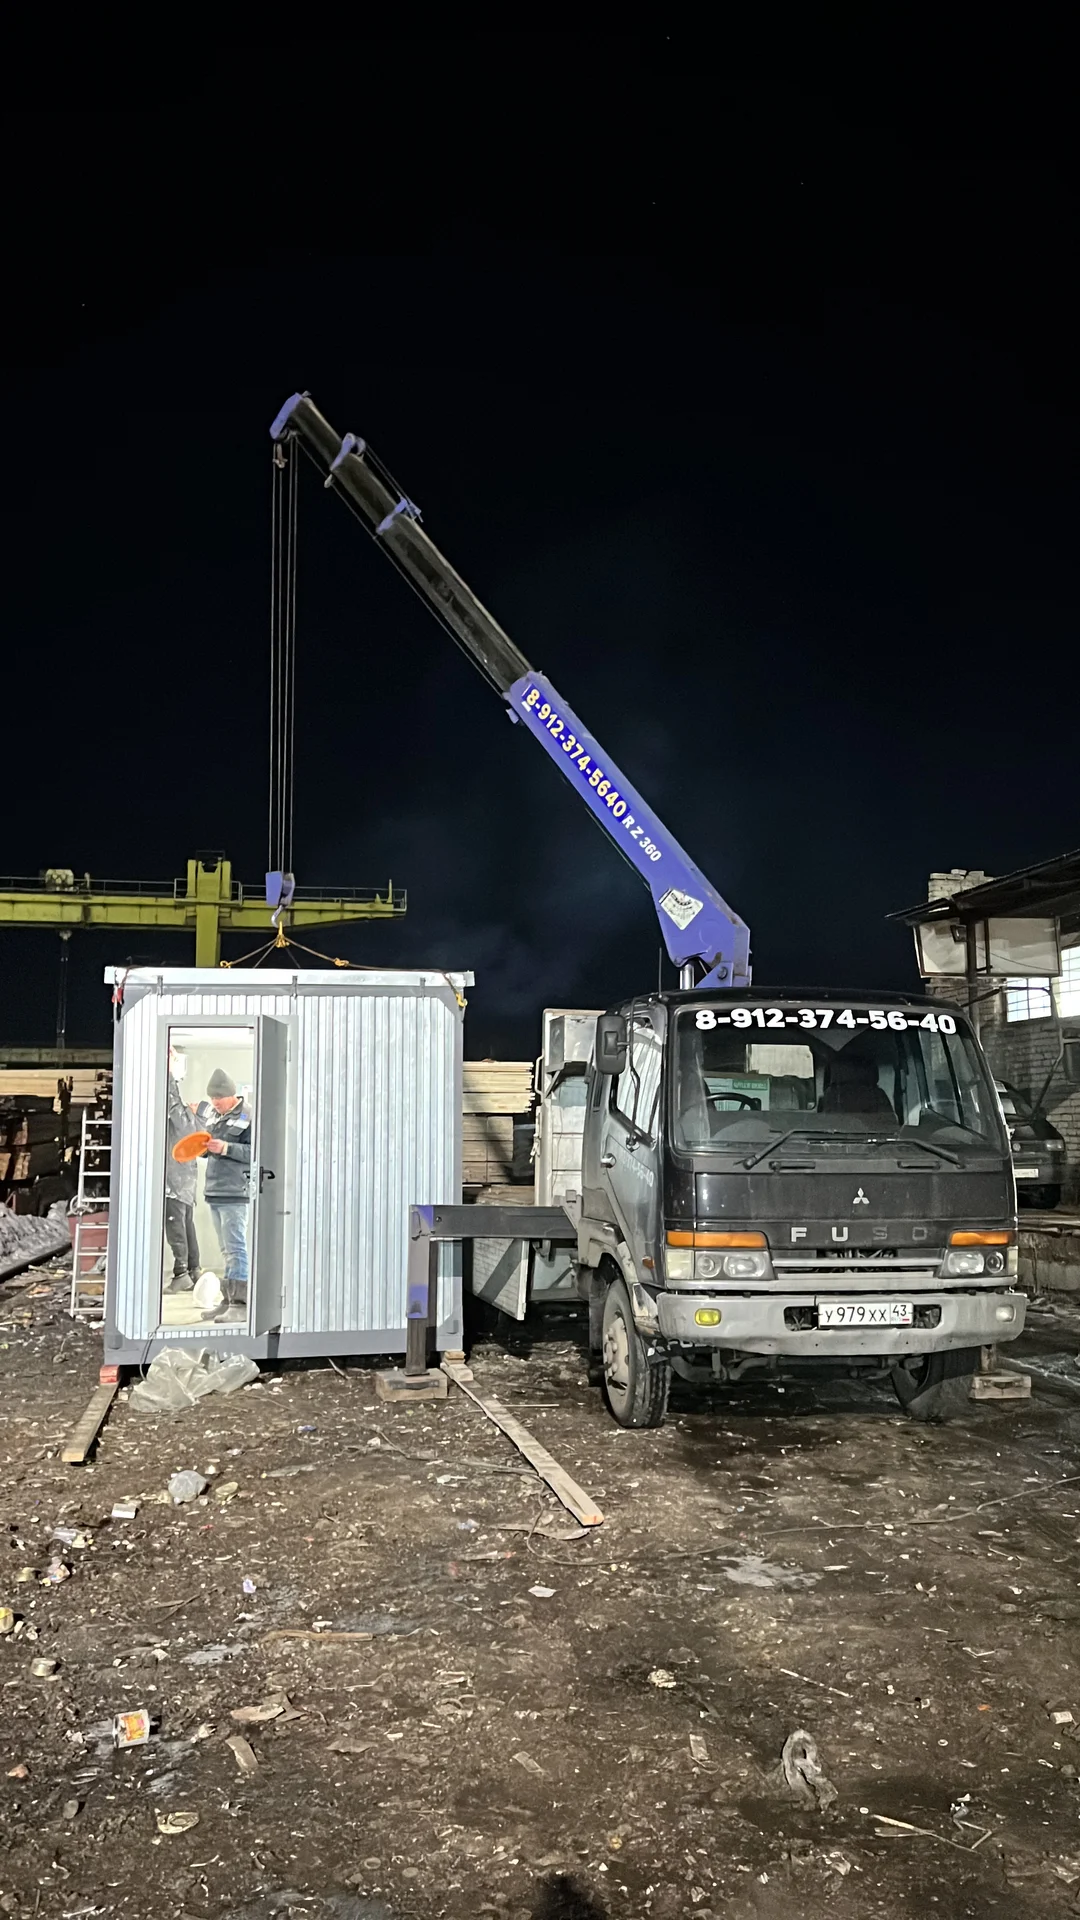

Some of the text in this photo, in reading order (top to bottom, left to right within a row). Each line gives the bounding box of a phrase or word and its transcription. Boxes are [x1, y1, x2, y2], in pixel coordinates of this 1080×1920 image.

[526, 688, 627, 817] 8-912-374-5640
[639, 837, 662, 862] 360
[695, 1008, 957, 1035] 8-912-374-56-40
[791, 1226, 927, 1242] FUSO
